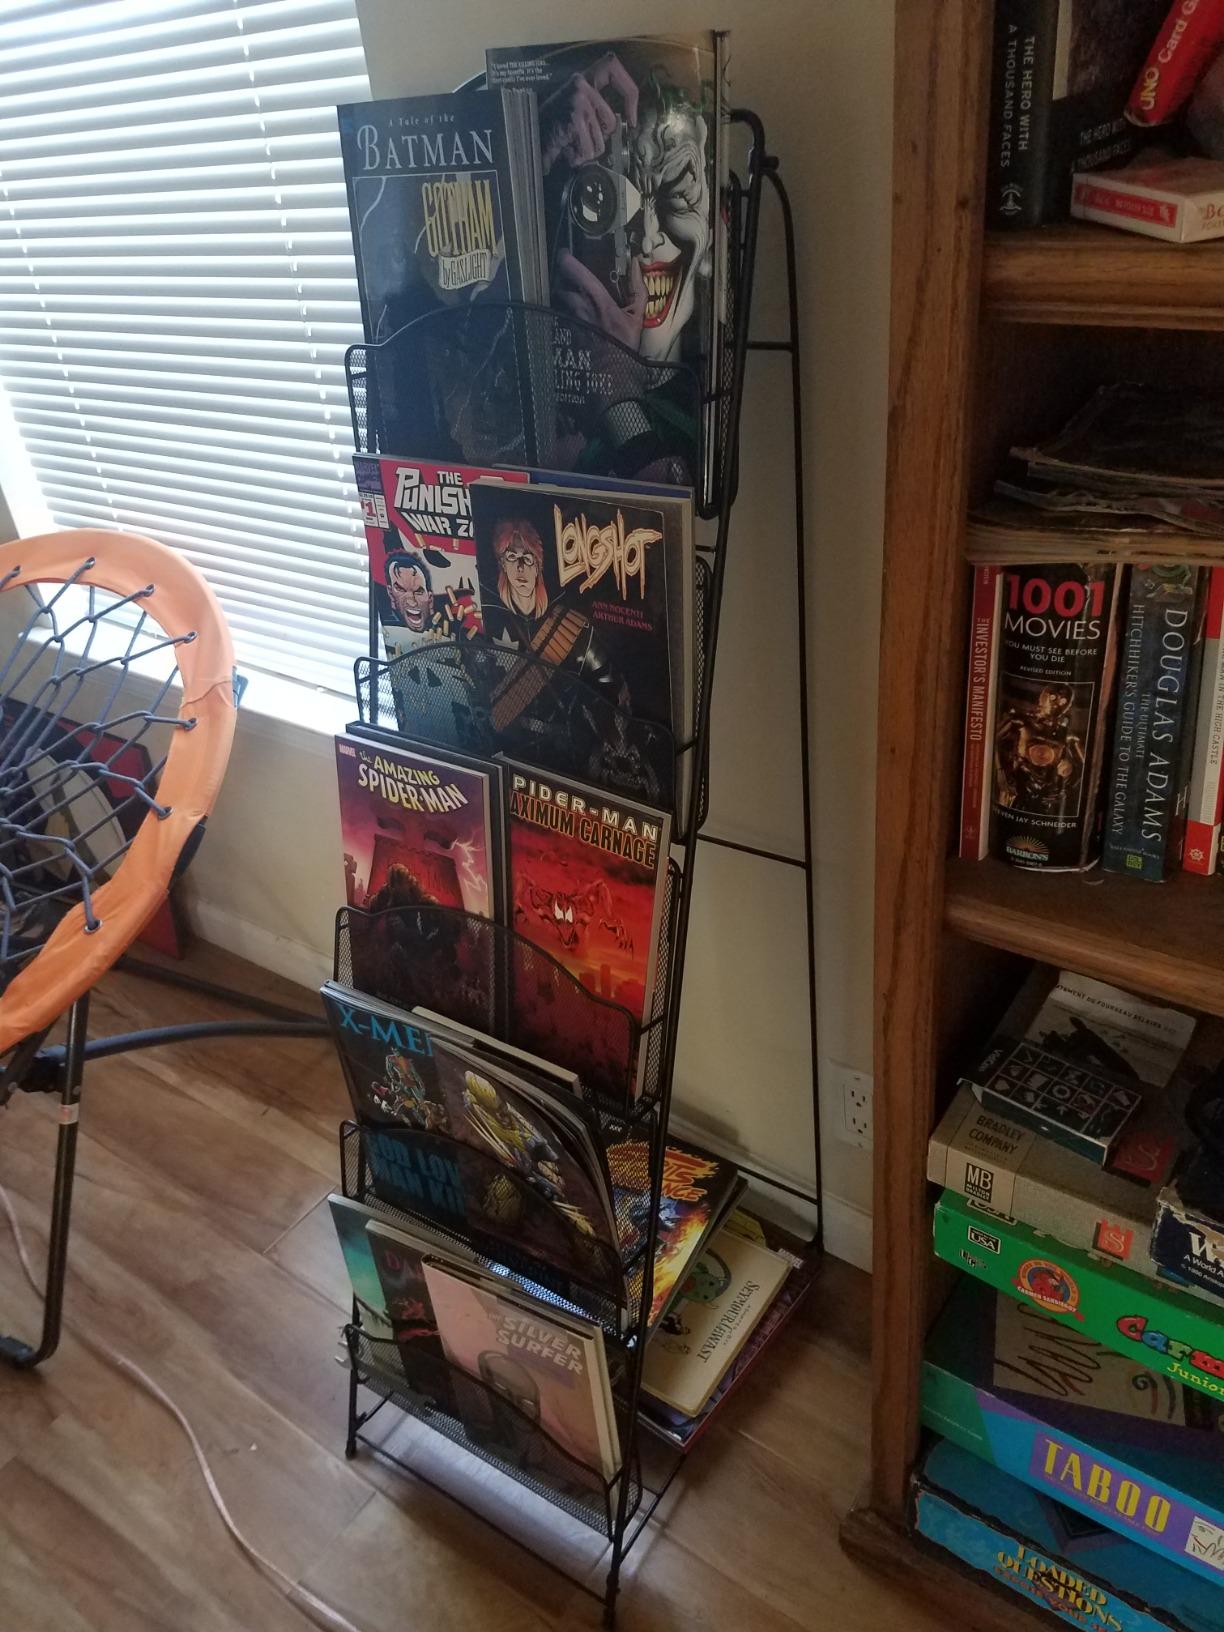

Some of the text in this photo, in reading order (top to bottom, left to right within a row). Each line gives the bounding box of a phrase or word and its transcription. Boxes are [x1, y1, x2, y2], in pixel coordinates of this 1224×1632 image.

[1140, 66, 1160, 110] UNO
[1158, 18, 1187, 63] Card
[1000, 24, 1018, 168] A THOUSAND FACES
[1018, 35, 1036, 151] THE HERO WITH
[399, 115, 419, 127] Tale
[424, 113, 434, 125] of
[439, 112, 455, 123] the
[357, 124, 494, 170] BATMAN
[421, 179, 497, 258] GOTHAM
[450, 252, 488, 285] GASLIGHT
[437, 470, 464, 486] THE
[401, 511, 453, 536] WAR
[553, 503, 664, 601] LONGSHOT
[1007, 574, 1106, 618] 1001
[1004, 611, 1101, 640] MOVIES
[973, 623, 990, 683] INVESTOR'S
[1022, 644, 1046, 653] MUST
[1048, 647, 1062, 655] SEE
[1064, 647, 1098, 656] BEFORE
[1030, 653, 1065, 663] YOU DIE
[1045, 668, 1072, 676] EDITION
[969, 686, 986, 741] MANIFESTO
[1119, 701, 1136, 743] GUIDE
[1141, 608, 1189, 842] DOUGLAS ADAMS
[373, 755, 440, 786] AMAZING
[1118, 746, 1131, 762] TO
[357, 763, 469, 814] SPIDER-MAN
[1115, 767, 1129, 790] THE
[1016, 816, 1028, 824] JAY
[1030, 820, 1077, 829] SCHNEIDER
[1111, 791, 1128, 836] GALAXY
[579, 816, 657, 870] CARNAGE
[968, 1127, 1019, 1155] COMPANY
[976, 1114, 1026, 1142] BRADLEY
[967, 1163, 993, 1191] MB
[970, 1232, 996, 1251] USA
[1192, 1256, 1217, 1274] World
[724, 1280, 761, 1327] SEYMOUR
[496, 1328, 585, 1377] SURFER
[502, 1316, 583, 1361] SILVER
[1043, 1438, 1172, 1534] TABOO
[997, 1551, 1124, 1631] QUESTIONS
[1017, 1544, 1108, 1606] LOADED
